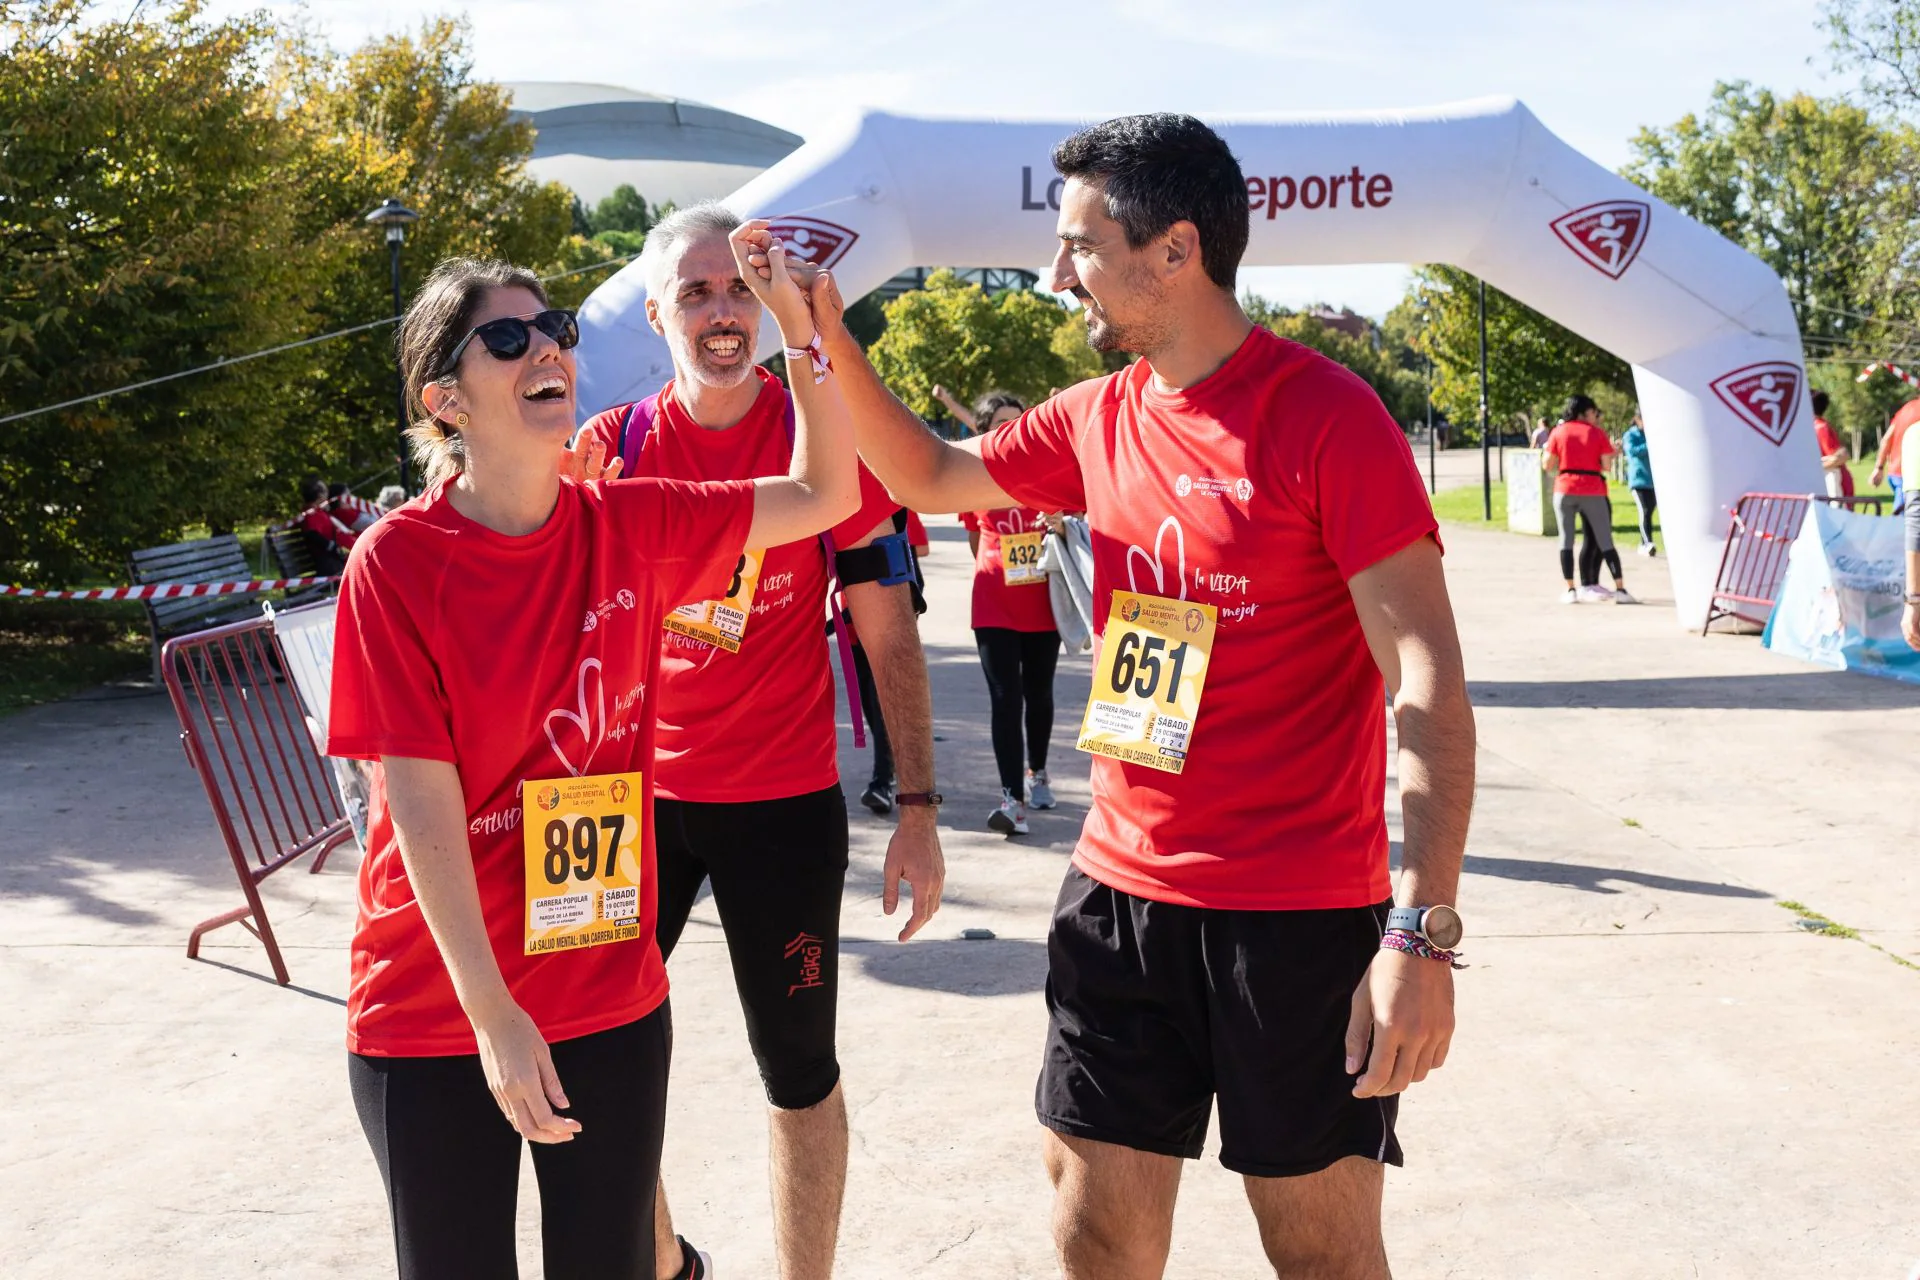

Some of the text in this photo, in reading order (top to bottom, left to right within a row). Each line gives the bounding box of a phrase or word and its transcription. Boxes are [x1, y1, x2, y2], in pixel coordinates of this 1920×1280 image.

[1245, 166, 1393, 220] eporte
[1193, 482, 1232, 492] SALUD MENTAL
[1009, 544, 1038, 566] 432
[764, 571, 794, 592] VIDA
[1195, 568, 1250, 594] la VIDA
[717, 605, 744, 620] SÁBADO
[1141, 608, 1180, 622] SALUD MENTAL
[1222, 602, 1259, 622] mejor
[699, 629, 718, 644] CARRERA
[1111, 632, 1188, 704] 651
[1096, 703, 1118, 714] CARRERA
[1120, 708, 1142, 718] POPULAR
[1158, 716, 1188, 731] SÁBADO
[1162, 730, 1186, 740] OCTUBRE
[1133, 750, 1155, 766] CARRERA
[1156, 757, 1163, 768] DE
[1164, 758, 1181, 772] FONDO
[562, 790, 606, 800] SALUD MENTAL
[470, 807, 522, 836] SALUD
[544, 814, 625, 884] 897
[536, 895, 588, 908] CARRERA POPULAR
[605, 889, 636, 901] SÁBADO
[613, 900, 636, 908] OCTUBRE
[529, 941, 537, 952] LA
[538, 938, 555, 950] SALUD
[580, 934, 590, 945] UNA
[591, 930, 613, 943] CARRERA
[614, 928, 621, 938] DE
[622, 926, 638, 938] FONDO
